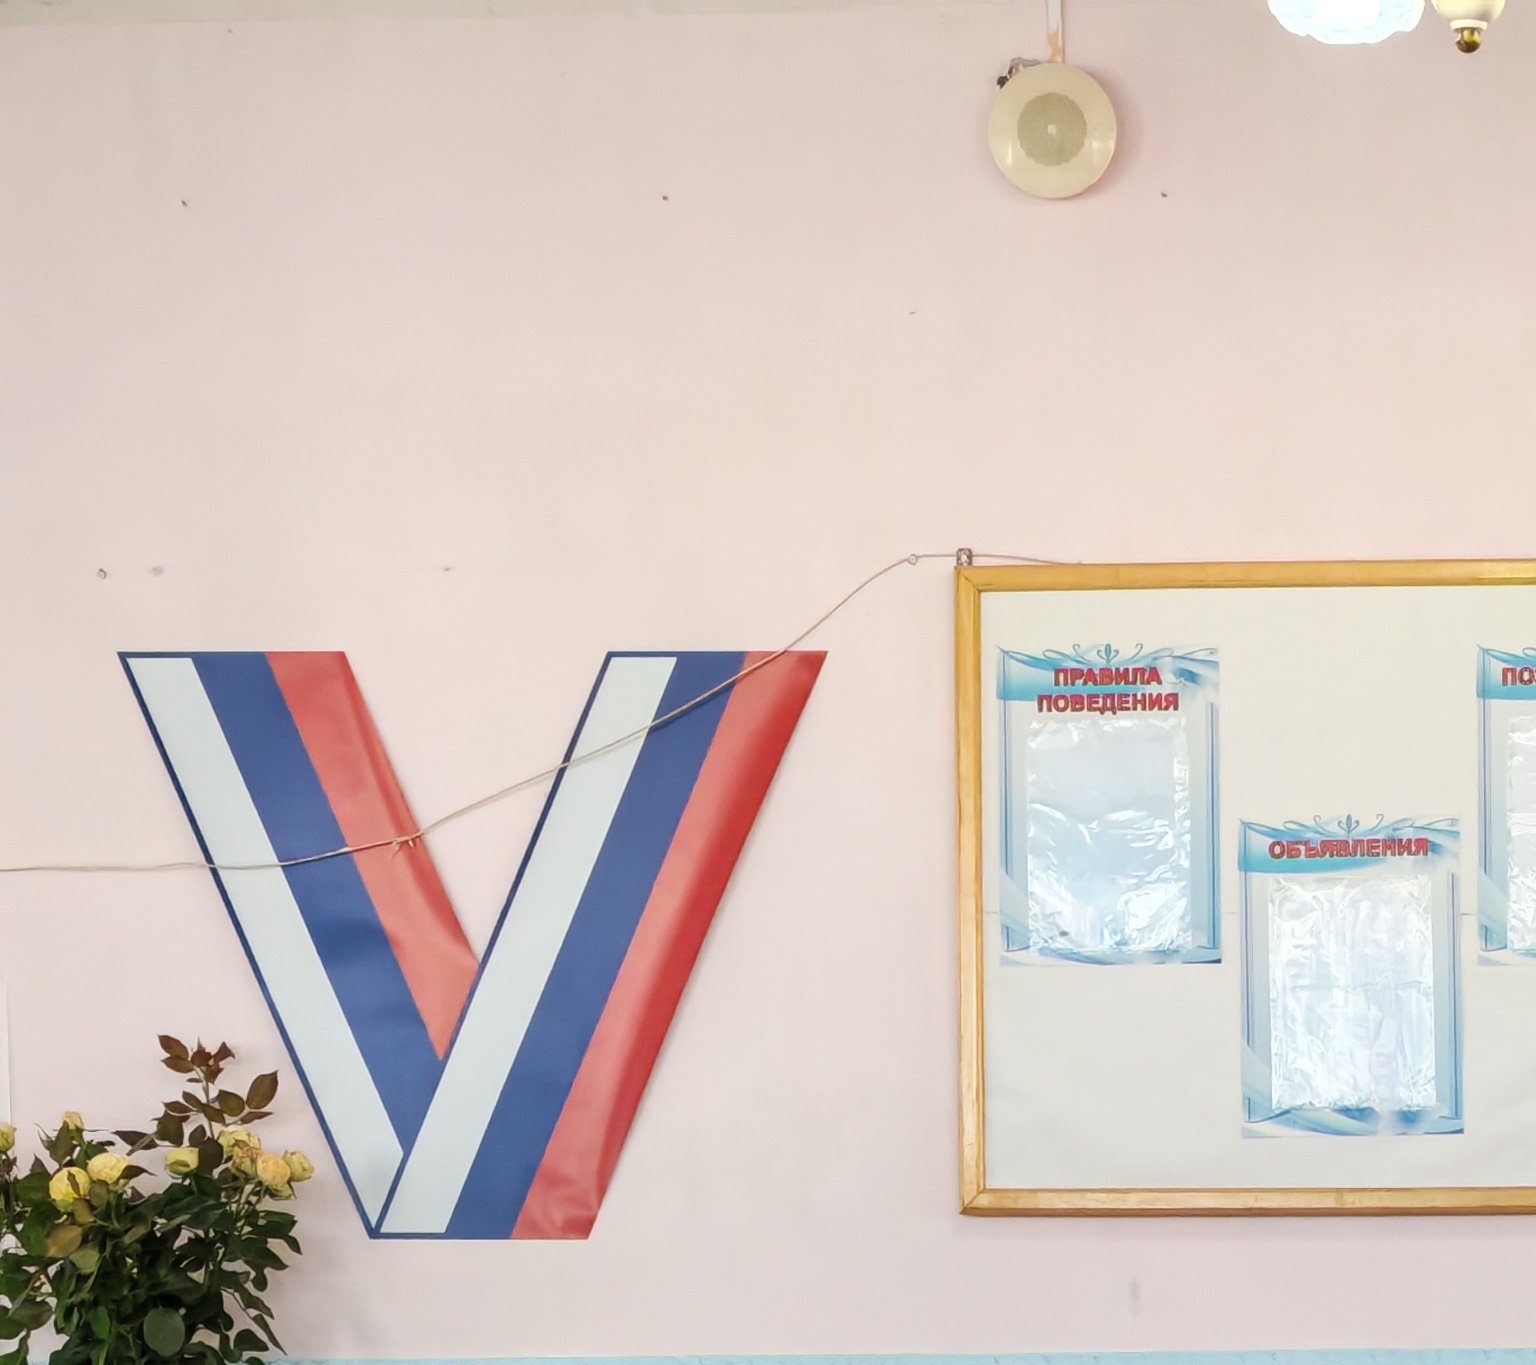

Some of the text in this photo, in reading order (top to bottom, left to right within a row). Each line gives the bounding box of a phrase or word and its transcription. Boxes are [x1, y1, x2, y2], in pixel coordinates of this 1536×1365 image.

[1053, 666, 1163, 687] ПРАВИЛА
[1036, 692, 1180, 716] ПОВЕДЕНИЯ
[1268, 837, 1429, 860] ОБЪЯВЛЕНИЯ
